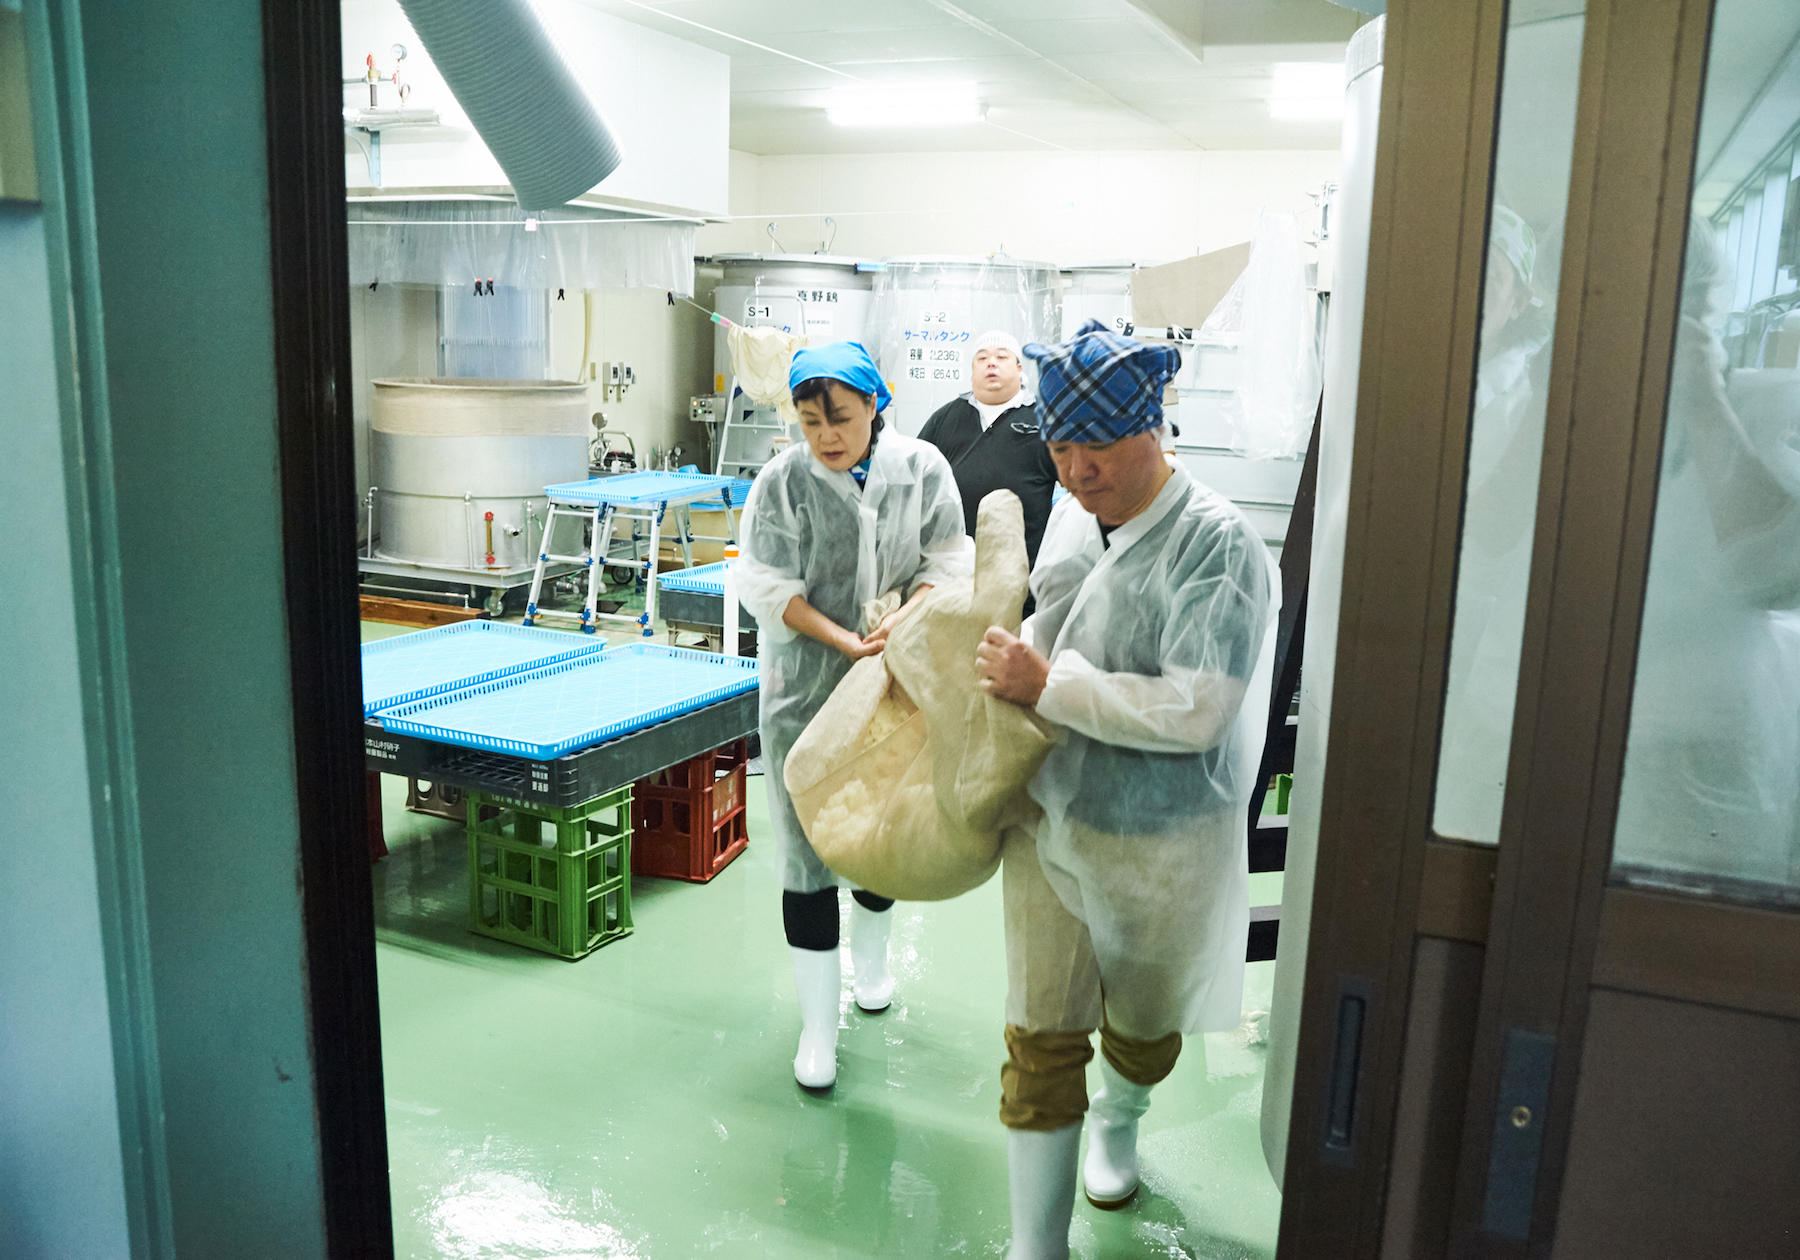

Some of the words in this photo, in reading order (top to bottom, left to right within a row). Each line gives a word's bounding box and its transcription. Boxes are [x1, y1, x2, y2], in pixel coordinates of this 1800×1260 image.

[748, 306, 770, 318] S-1
[923, 311, 947, 323] S-2
[365, 739, 400, 752] 本山村硝子
